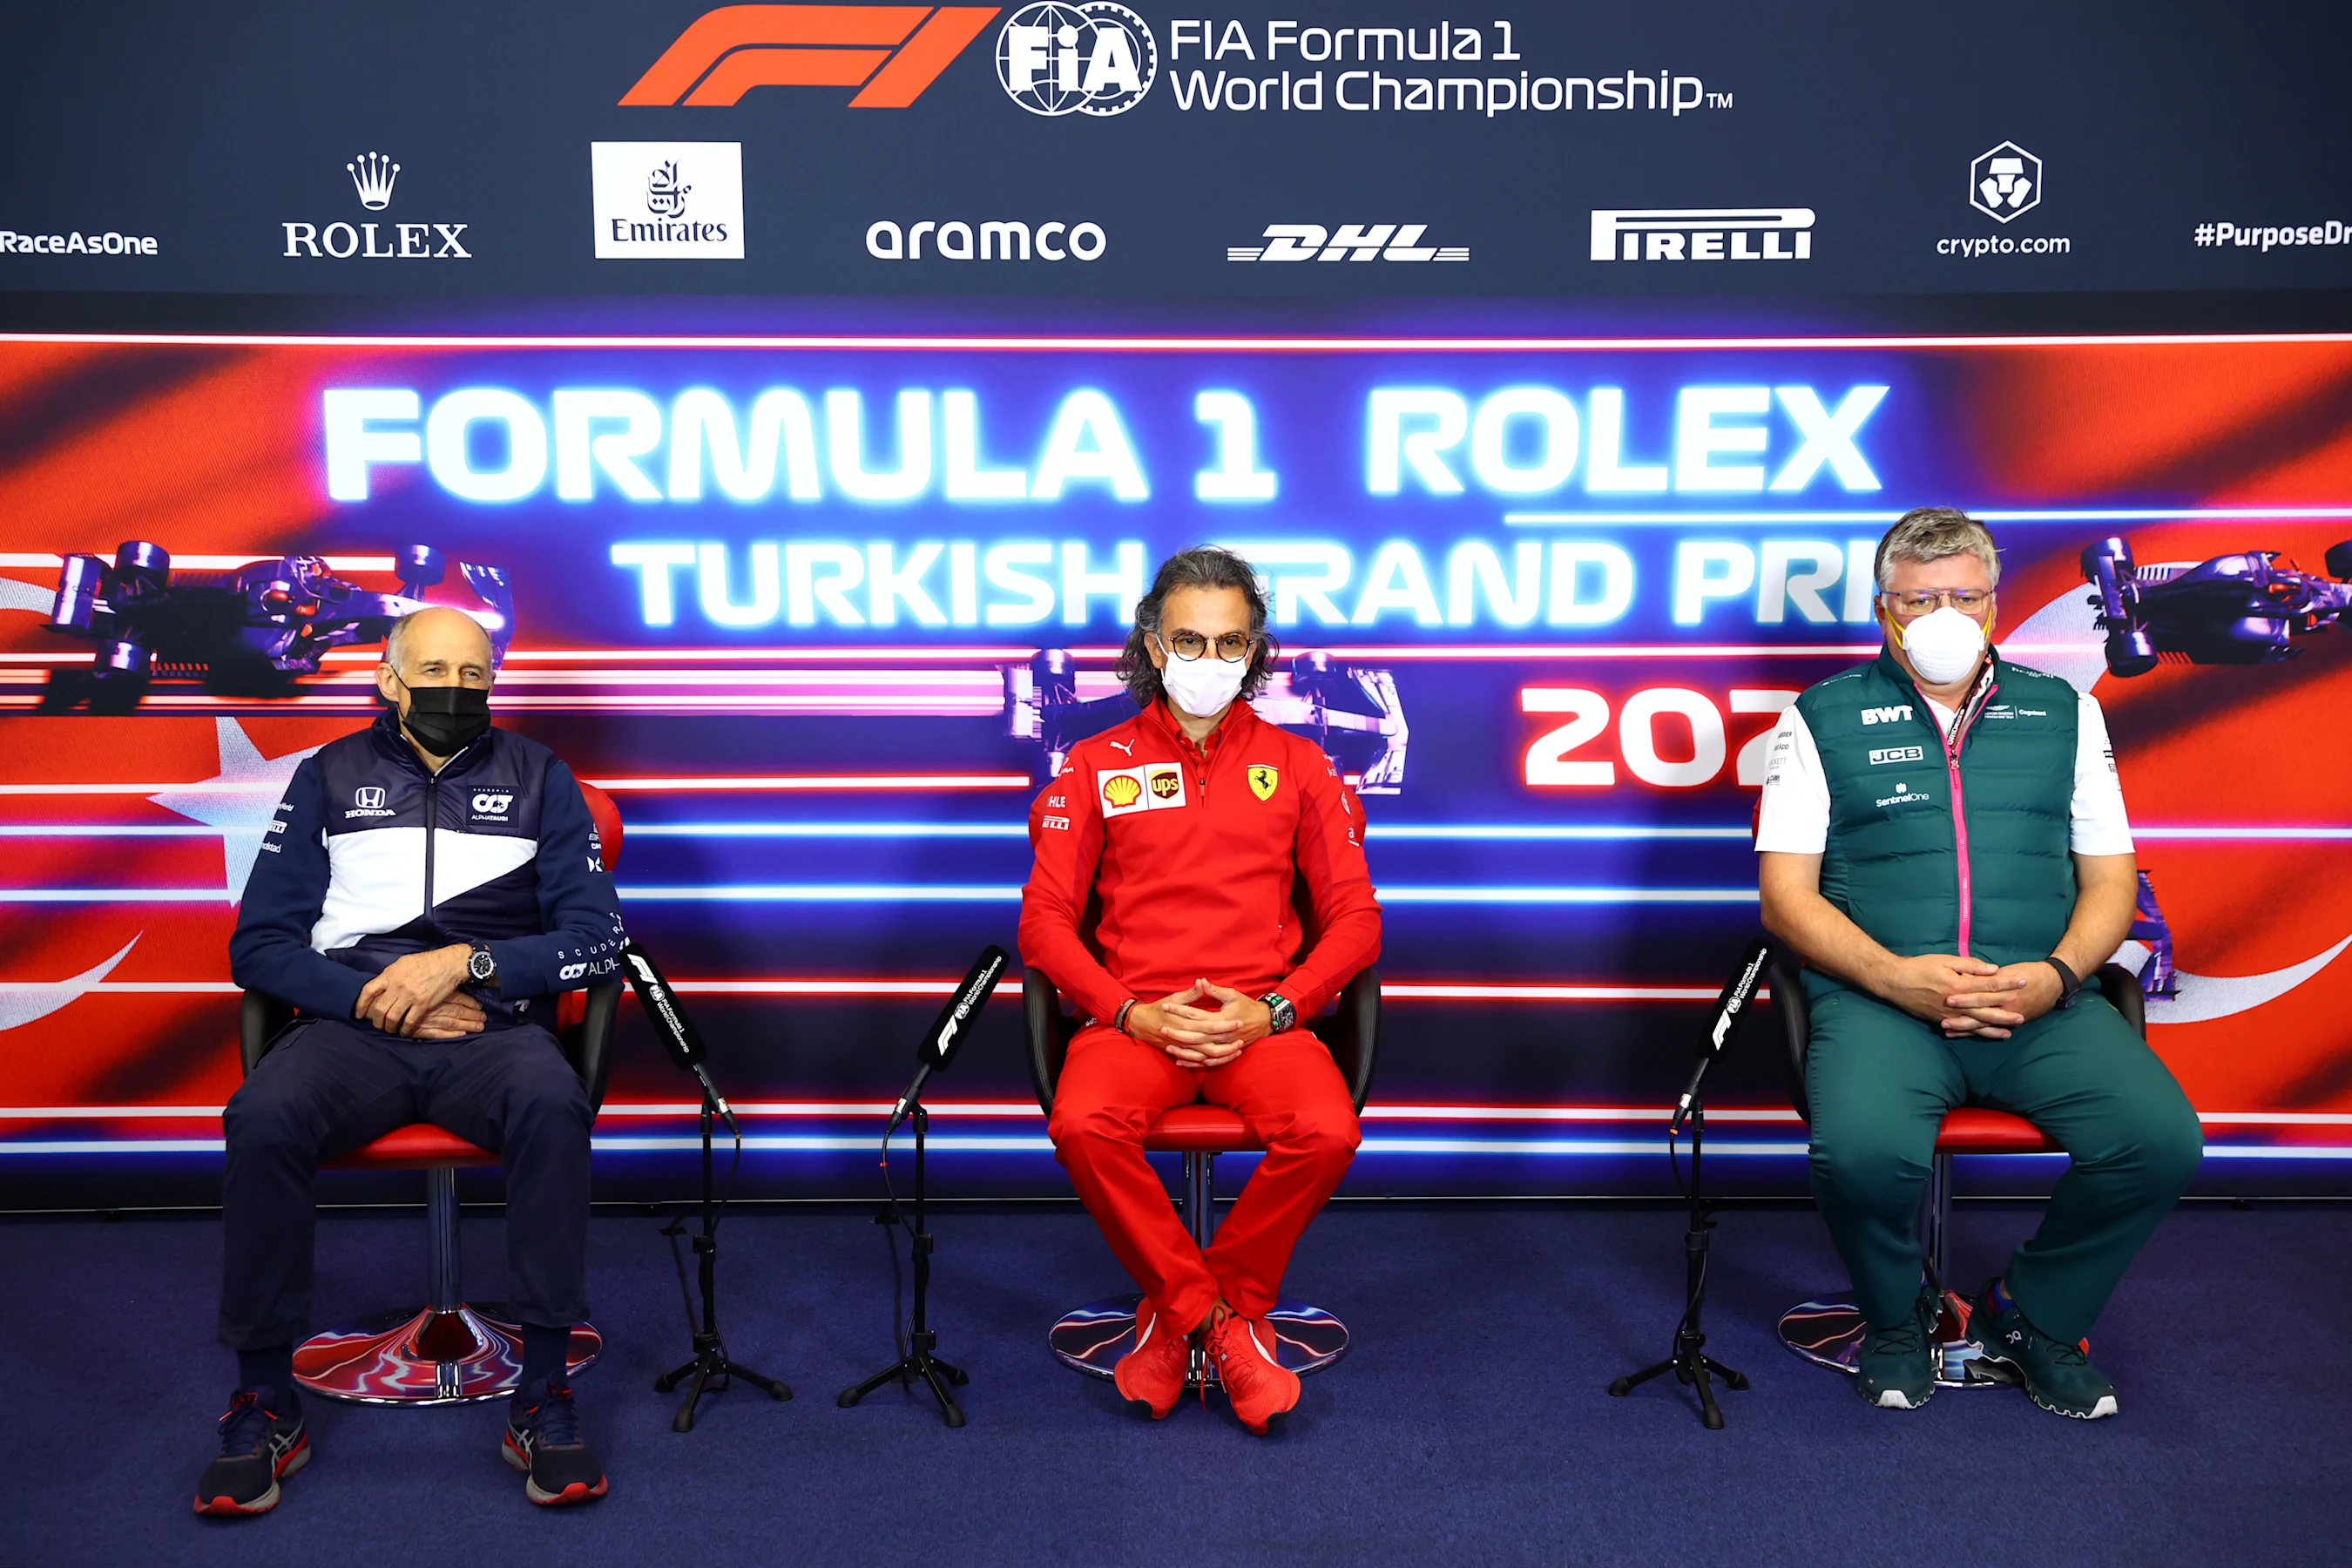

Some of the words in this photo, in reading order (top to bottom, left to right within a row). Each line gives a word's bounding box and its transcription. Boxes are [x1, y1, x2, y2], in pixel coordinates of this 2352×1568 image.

[1172, 20, 1255, 61] FIA
[1268, 20, 1481, 61] Formula
[1492, 21, 1521, 61] 1
[1169, 69, 1322, 111] World
[282, 222, 472, 259] ROLEX
[612, 218, 728, 242] Emirates
[866, 221, 1107, 261] aramco
[1591, 208, 1816, 261] PIRELLI
[0, 231, 159, 255] RaceAsOne
[1260, 225, 1437, 262] DHL
[1936, 233, 2072, 258] crypto.com
[324, 389, 1149, 501] FORMULA
[1198, 392, 1274, 498] 1
[1369, 386, 1890, 493] ROLEX
[612, 543, 1142, 625] TURKISH
[1209, 542, 1633, 625] RAND
[1674, 540, 1878, 624] PRI
[1861, 705, 1914, 726] BWT
[1873, 748, 1921, 762] JCB
[1152, 778, 1179, 797] ups
[1047, 795, 1066, 808] HLE
[1876, 793, 1930, 808] SentinelOne
[345, 808, 397, 819] HONDA
[1041, 814, 1071, 831] ELLI
[968, 989, 981, 1005] World
[977, 956, 1002, 991] Championship
[969, 973, 984, 995] Formula
[1738, 965, 1752, 988] Formula
[1739, 983, 1751, 999] World
[1747, 948, 1767, 984] Championship
[657, 1002, 668, 1018] World
[666, 1017, 690, 1053] Championship
[667, 1007, 683, 1030] Formula
